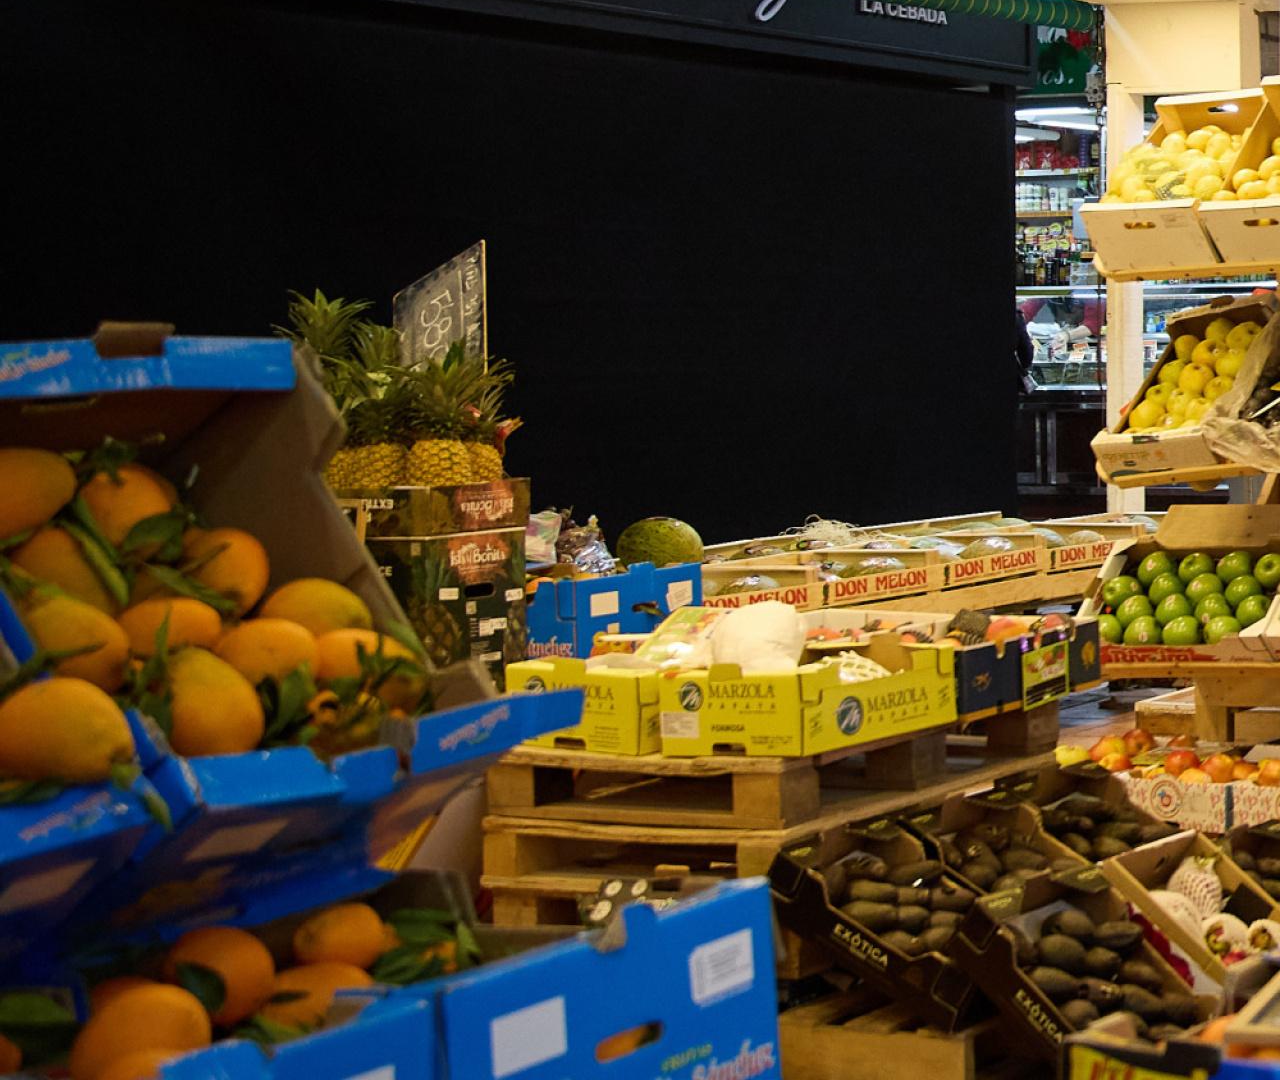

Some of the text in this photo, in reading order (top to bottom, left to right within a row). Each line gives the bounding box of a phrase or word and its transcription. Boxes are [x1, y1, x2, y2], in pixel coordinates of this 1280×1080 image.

[954, 550, 1037, 578] DON MELON
[1060, 545, 1087, 563] DON
[835, 569, 928, 598] DON MELON
[708, 683, 775, 699] MARZOLA
[867, 686, 929, 713] MARZOLA
